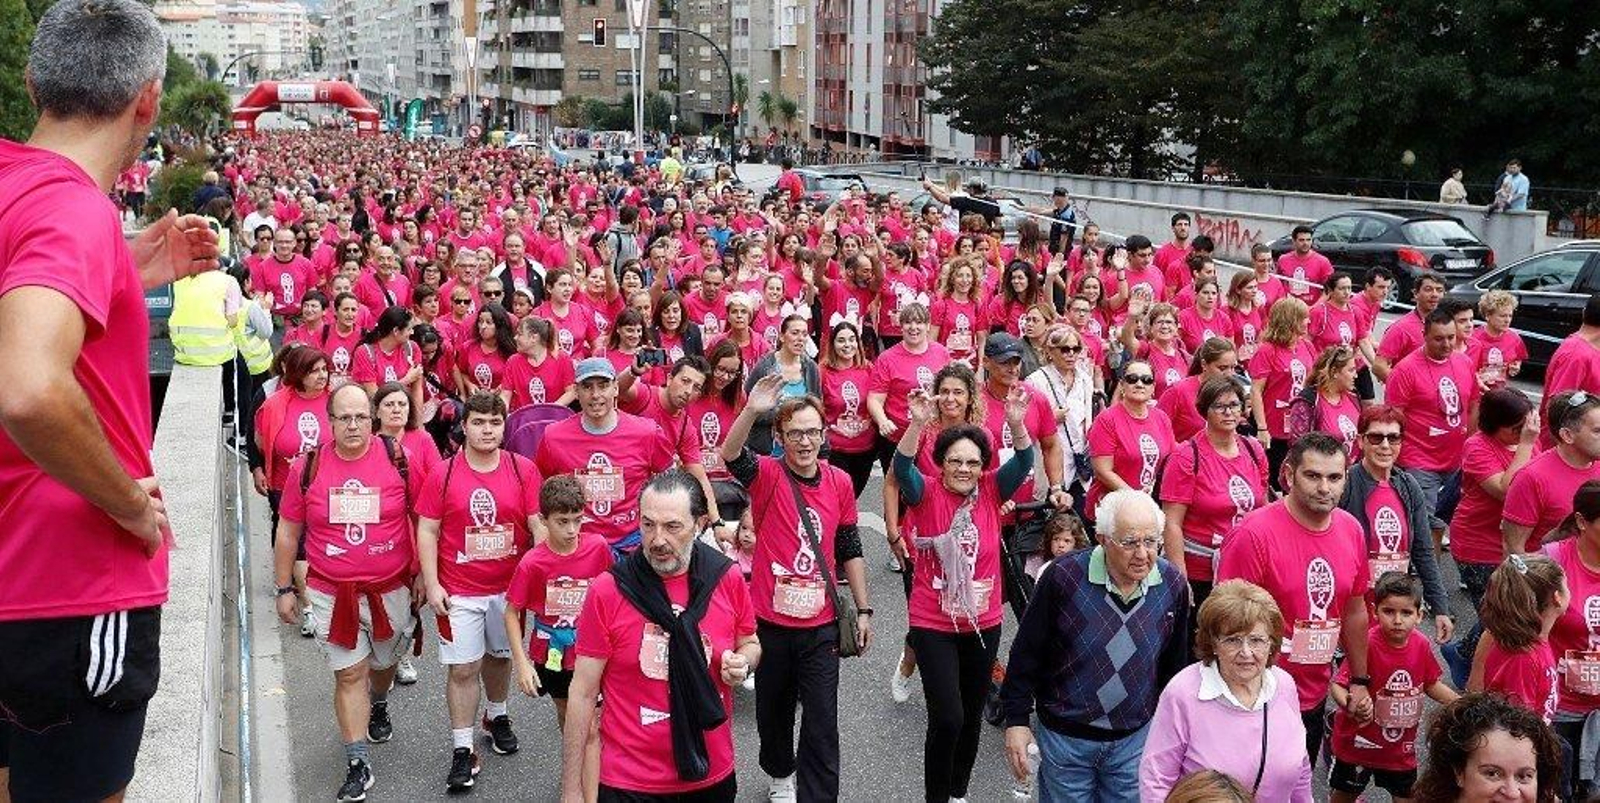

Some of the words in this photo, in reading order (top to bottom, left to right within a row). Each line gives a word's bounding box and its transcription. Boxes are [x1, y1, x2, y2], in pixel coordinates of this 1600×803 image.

[586, 478, 615, 491] 4503
[340, 498, 371, 514] 3209
[475, 534, 506, 551] 3208
[1309, 633, 1331, 651] 5131
